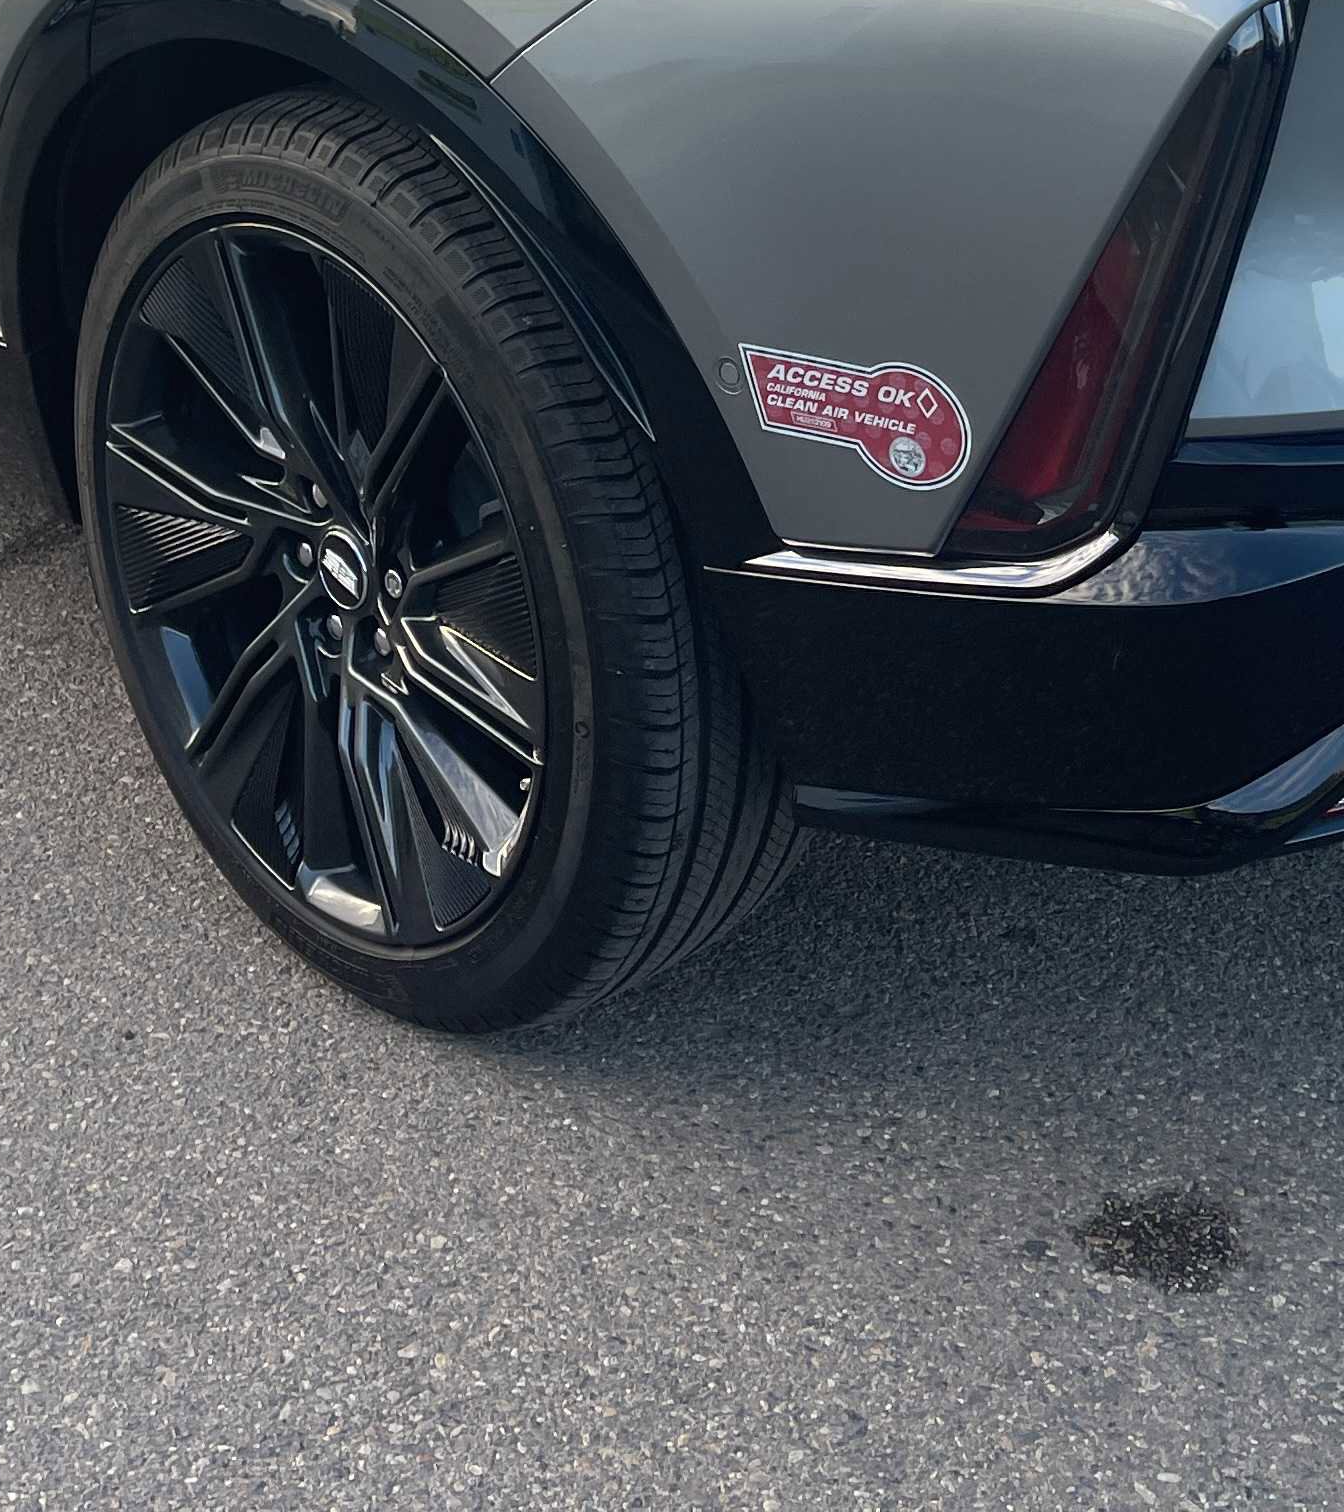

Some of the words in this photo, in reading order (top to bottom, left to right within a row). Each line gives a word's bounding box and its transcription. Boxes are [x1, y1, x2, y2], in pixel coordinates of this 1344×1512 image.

[766, 382, 826, 402] CALIFORNIA
[767, 364, 870, 398] ACCESS
[877, 385, 916, 408] OK
[766, 394, 819, 414] CLEAN
[822, 404, 849, 420] AIR
[855, 411, 917, 435] VEHICLE
